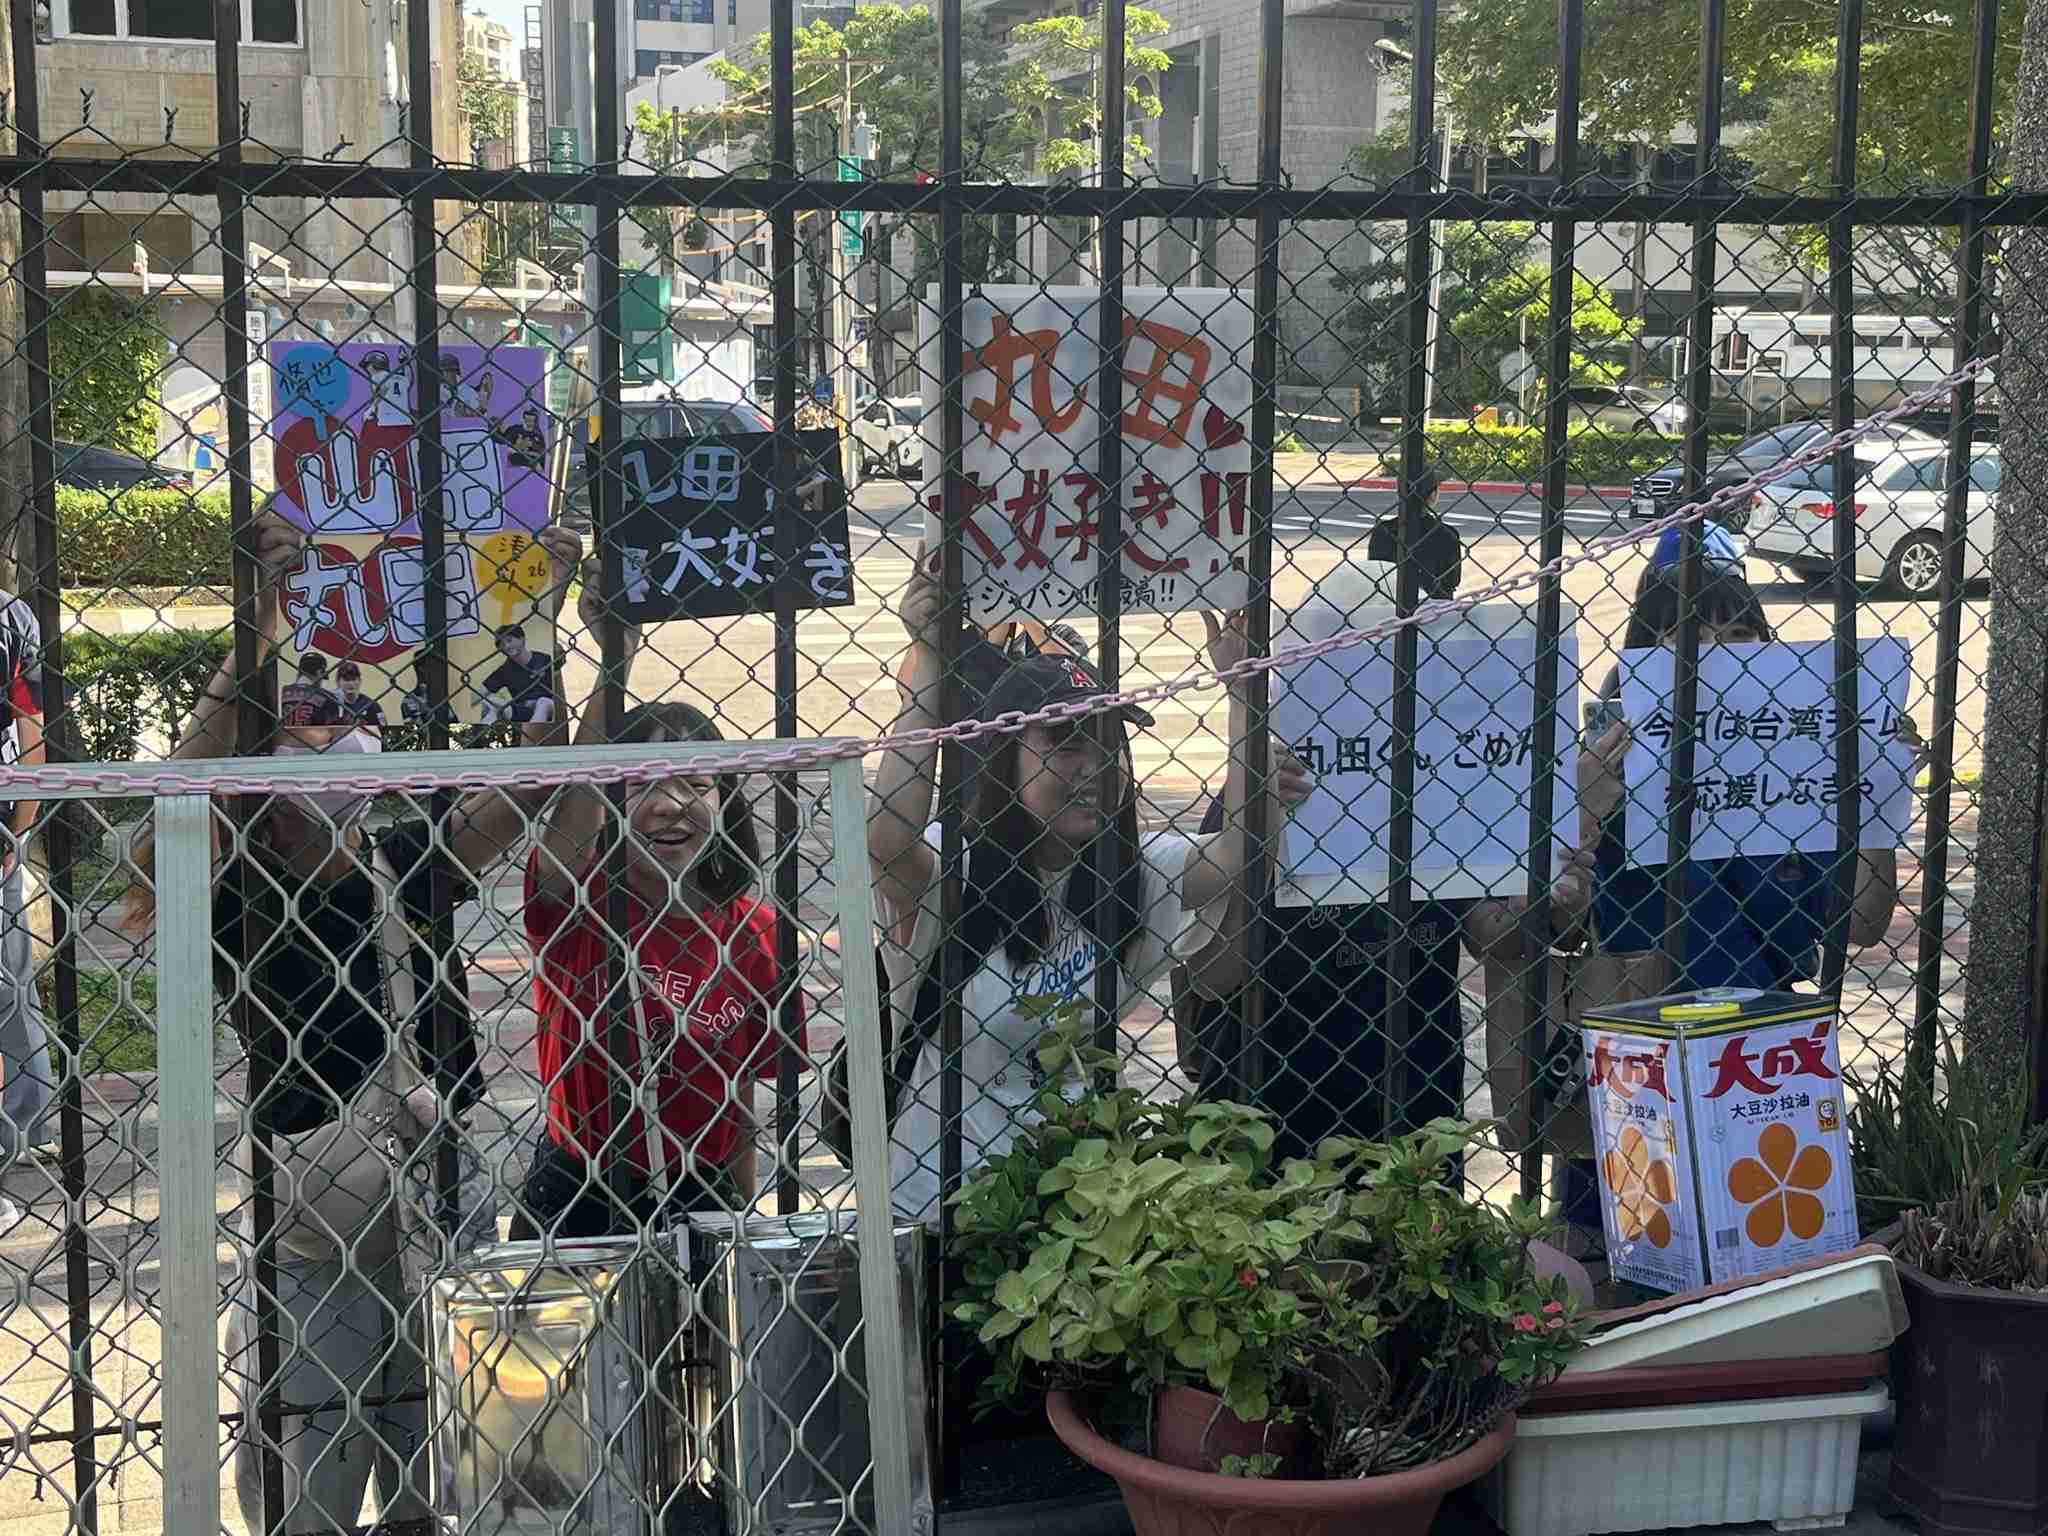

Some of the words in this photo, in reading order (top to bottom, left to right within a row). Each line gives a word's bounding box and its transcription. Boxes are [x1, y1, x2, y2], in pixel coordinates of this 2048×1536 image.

[962, 313, 1212, 449] 丸田
[297, 428, 504, 533] 山田
[287, 541, 480, 651] 丸田
[1665, 772, 1875, 813] 応援しなきゃ
[1700, 1020, 1839, 1099] 大成
[1730, 1091, 1811, 1121] 大豆沙拉油
